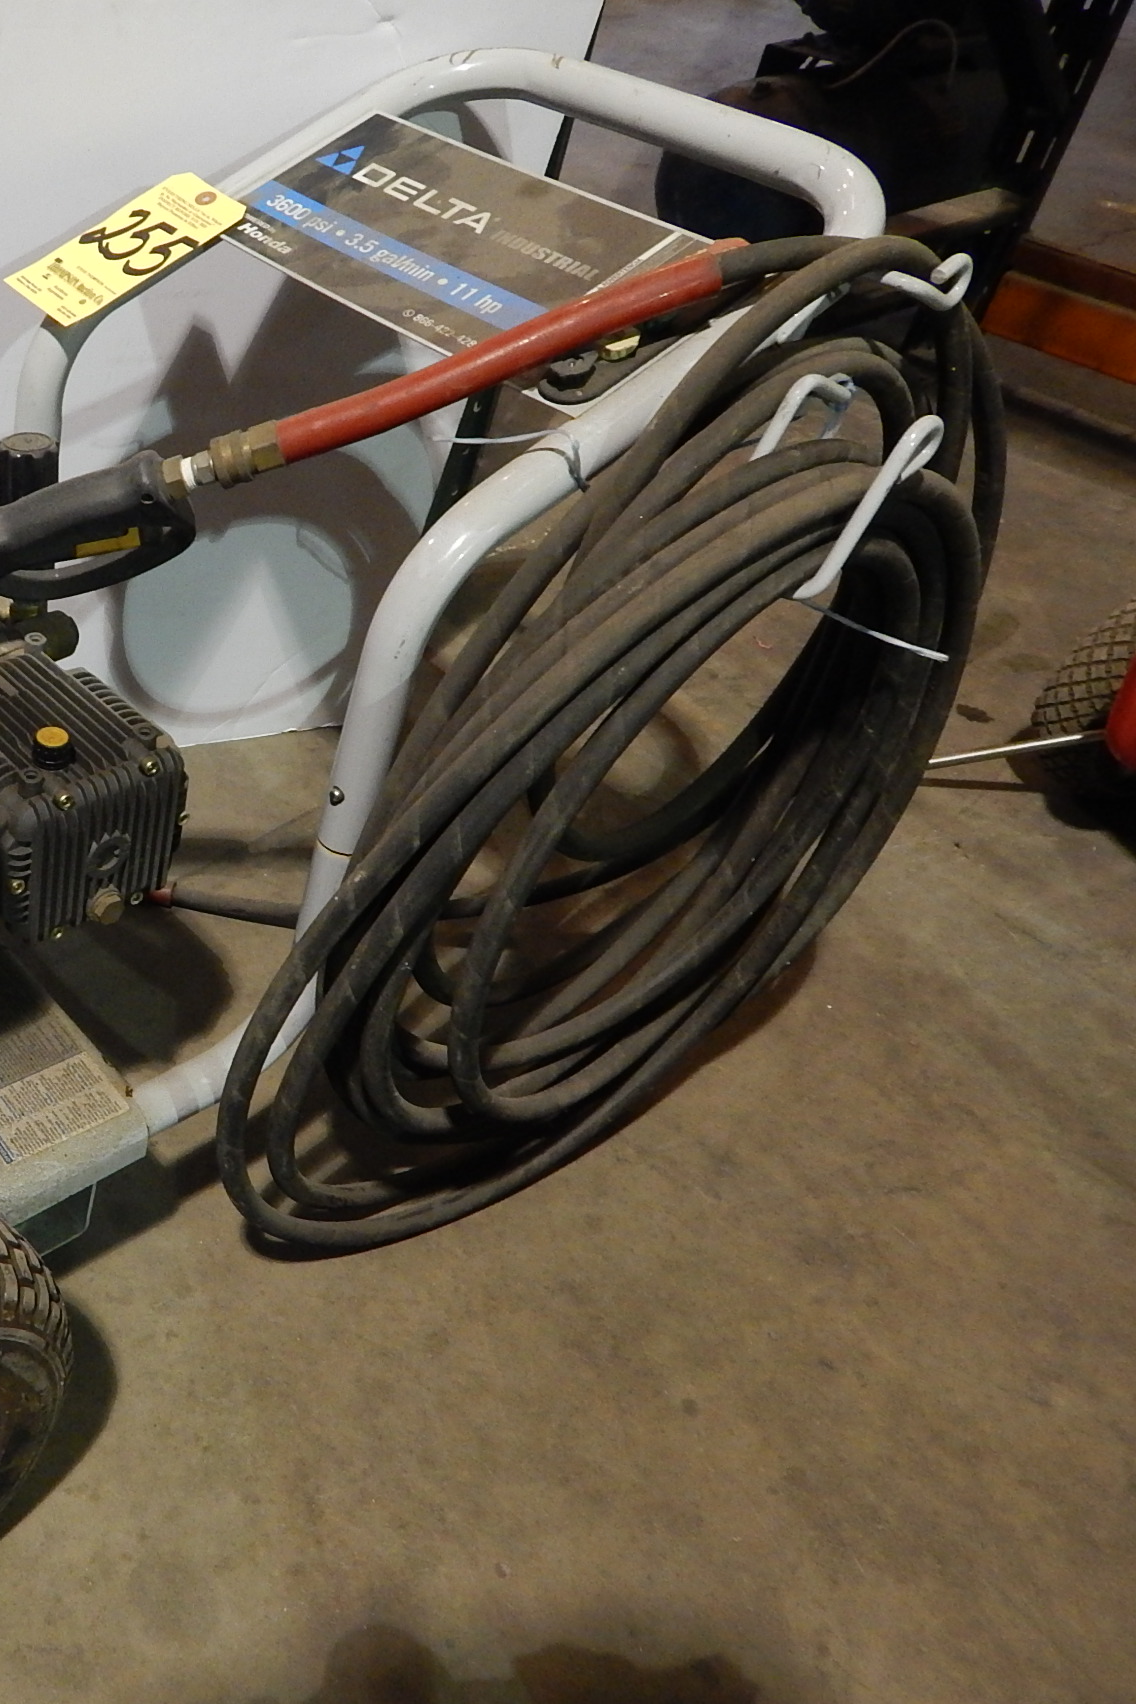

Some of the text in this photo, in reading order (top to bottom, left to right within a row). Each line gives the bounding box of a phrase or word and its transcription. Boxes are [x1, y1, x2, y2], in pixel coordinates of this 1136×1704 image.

[78, 208, 200, 276] 255
[236, 222, 292, 254] Honda
[266, 194, 503, 314] 3600 psi 3.5 gal/min 11 hp
[352, 162, 492, 234] DELTA
[489, 230, 600, 281] INDUSTRIAL
